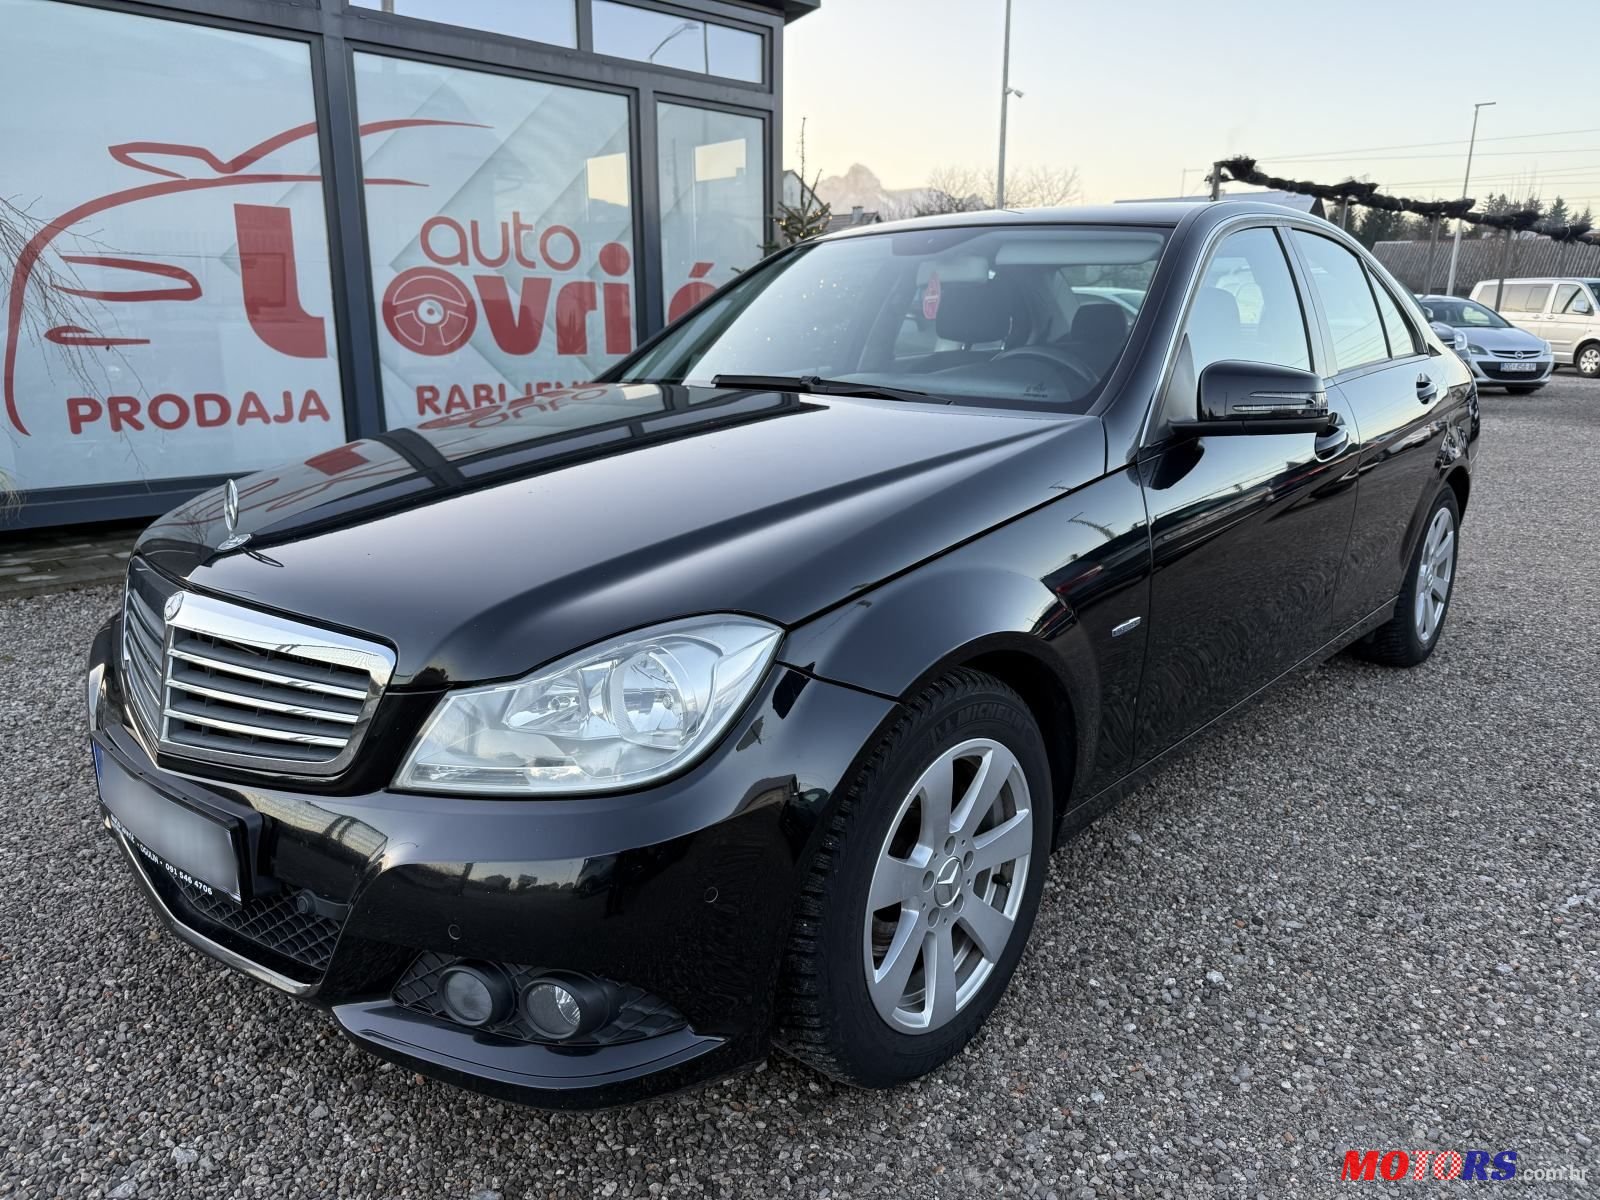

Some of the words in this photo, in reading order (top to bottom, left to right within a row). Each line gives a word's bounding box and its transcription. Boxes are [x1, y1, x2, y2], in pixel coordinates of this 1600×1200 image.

[420, 211, 581, 271] auto
[67, 389, 331, 435] PRODAJA
[165, 863, 178, 876] 091
